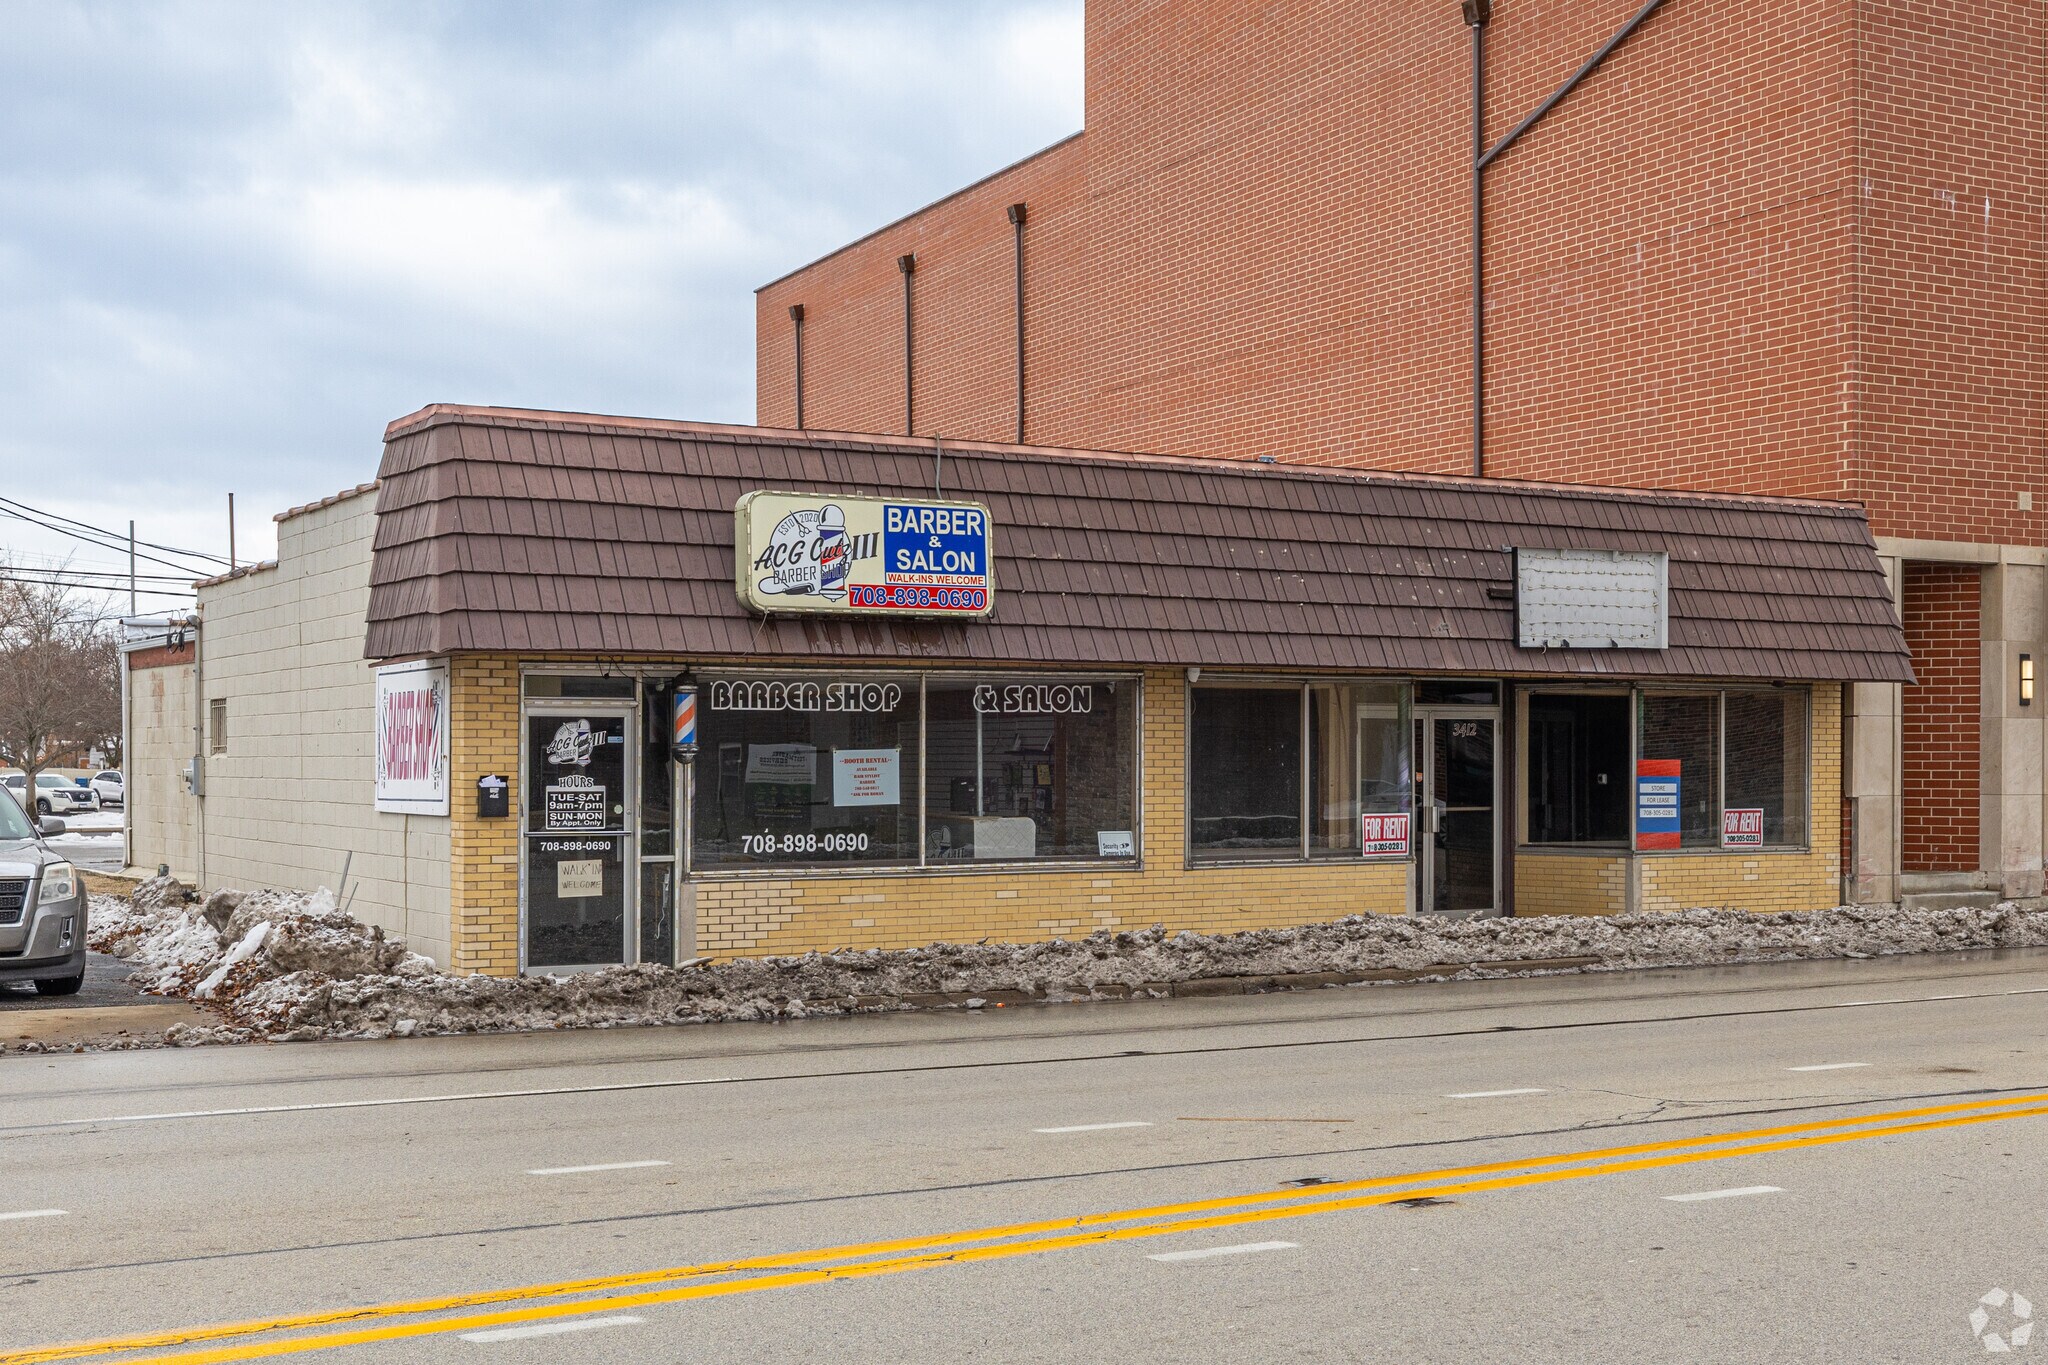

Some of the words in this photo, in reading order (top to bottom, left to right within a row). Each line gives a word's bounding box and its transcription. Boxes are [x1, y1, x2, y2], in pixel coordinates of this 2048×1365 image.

[778, 519, 795, 536] ESTD
[799, 513, 819, 524] 2020
[887, 508, 982, 535] BARBER
[754, 540, 806, 570] ACG
[810, 537, 853, 567] Cutz
[852, 532, 880, 560] III
[928, 536, 942, 548] &
[896, 549, 975, 572] SALON
[773, 565, 817, 584] BARBER
[888, 573, 934, 584] WALK-INS
[936, 575, 984, 585] WELCOME
[851, 587, 985, 608] 708-898-0690
[711, 681, 820, 711] BARBER
[826, 683, 901, 712] SHOP
[973, 685, 1000, 712] &
[1003, 685, 1092, 713] SALON
[387, 691, 414, 780] BARBER
[414, 689, 434, 781] SHOP
[1452, 722, 1477, 738] 3412
[547, 737, 572, 753] ACG
[559, 775, 594, 788] HOURS
[549, 801, 603, 811] 9am-7pm
[550, 793, 602, 801] TUE-SAT
[549, 812, 602, 820] SUN-MON
[1725, 813, 1739, 832] FOR
[1739, 812, 1760, 832] RENT
[1365, 818, 1381, 840] FOR
[1383, 817, 1407, 839] RENT
[540, 841, 611, 851] 708-898-0690
[741, 832, 869, 854] 708-898-0690
[562, 880, 602, 889] WELCOME
